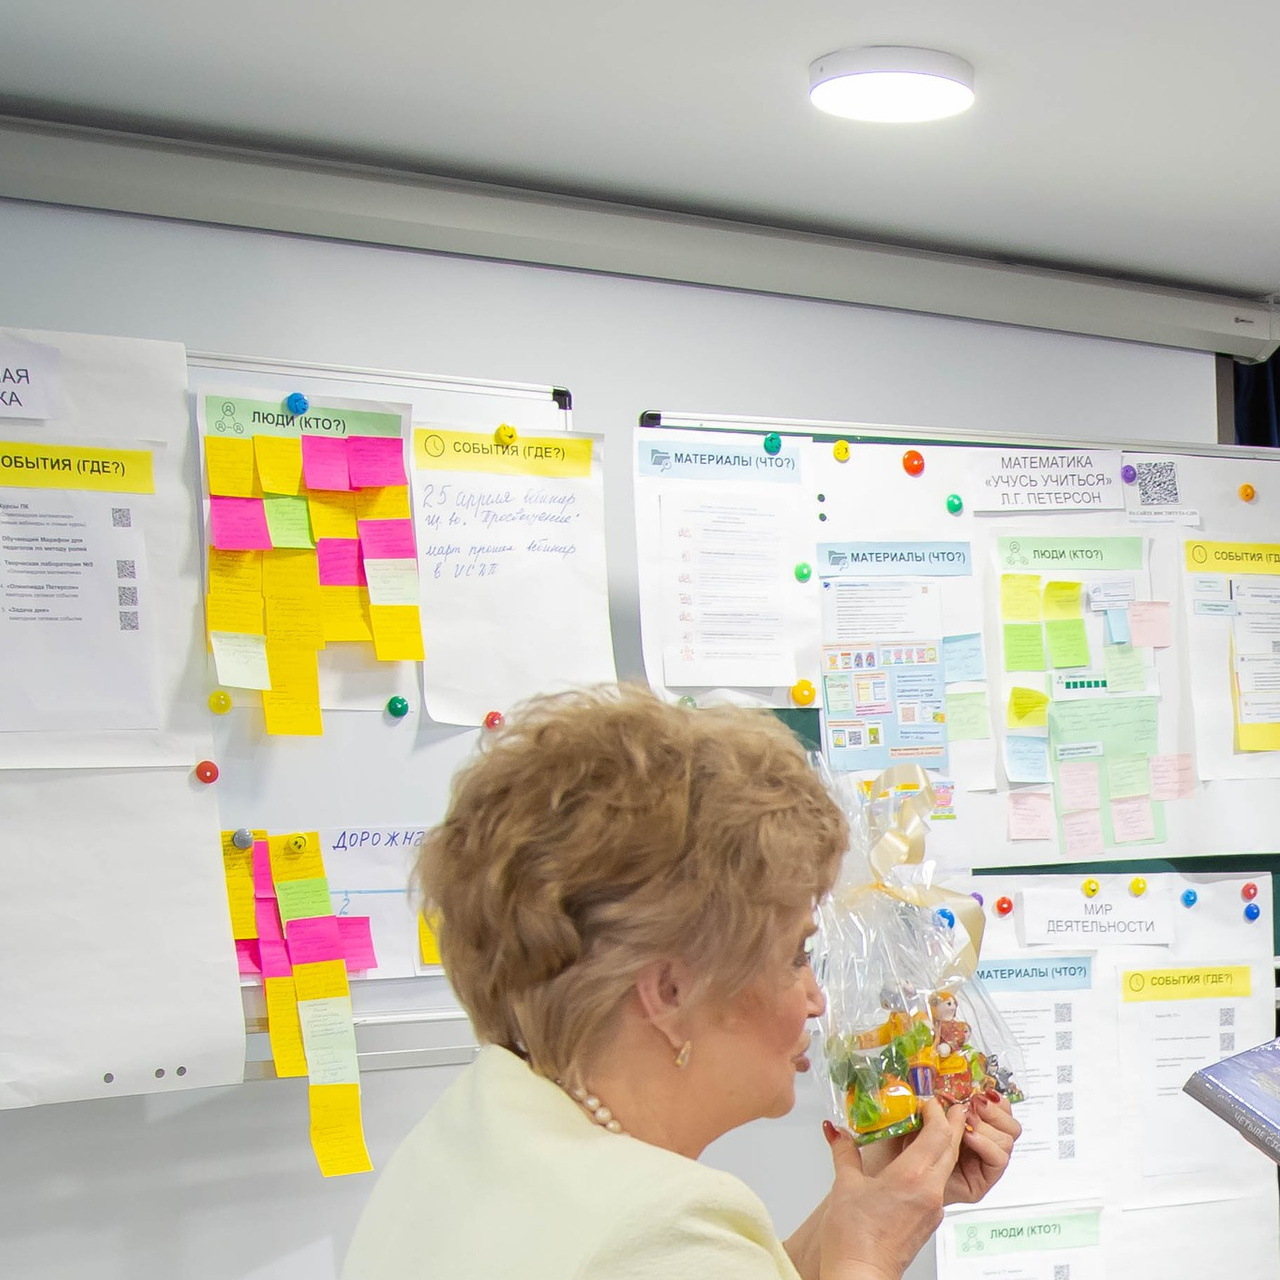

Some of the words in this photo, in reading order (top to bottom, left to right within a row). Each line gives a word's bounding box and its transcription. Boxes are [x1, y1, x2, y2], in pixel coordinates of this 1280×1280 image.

[252, 411, 295, 428] ЛЮДИ
[300, 416, 346, 434] (КТО?)
[453, 441, 519, 456] СОБЫТИЯ
[523, 446, 565, 460] (ГДЕ?)
[1, 455, 72, 471] ОБЫТИЯ
[77, 459, 126, 477] (ГДЕ?)
[674, 453, 752, 466] МАТЕРИАЛЫ
[755, 456, 795, 470] (ЧТО?)
[1001, 456, 1093, 469] МАТЕМАТИКА
[985, 475, 1038, 487] «УЧУСЬ
[1041, 474, 1112, 487] УЧИТЬСЯ»
[423, 484, 451, 507] 25
[1001, 493, 1024, 505] Л.Г.
[1027, 492, 1101, 504] ПЕТЕРСОН
[850, 552, 925, 562] МАТЕРИАЛЫ
[928, 551, 966, 564] (ЧТО?)
[1033, 549, 1066, 560] ЛЮДИ
[1069, 549, 1103, 561] (КТО?)
[1214, 551, 1262, 562] СОБЫТИЯ
[1084, 904, 1112, 915] МИР
[1047, 920, 1155, 933] ДЕЯТЕЛЬНОСТИ
[977, 968, 1048, 979] МАТЕРИАЛЫ
[1052, 966, 1087, 979] (ЧТО?)
[1151, 975, 1200, 986] СОБЫТИЯ
[1203, 974, 1232, 985] (ГДЕ?)
[991, 1227, 1023, 1239] ЛЮДИ
[1027, 1224, 1061, 1237] (КТО?)
